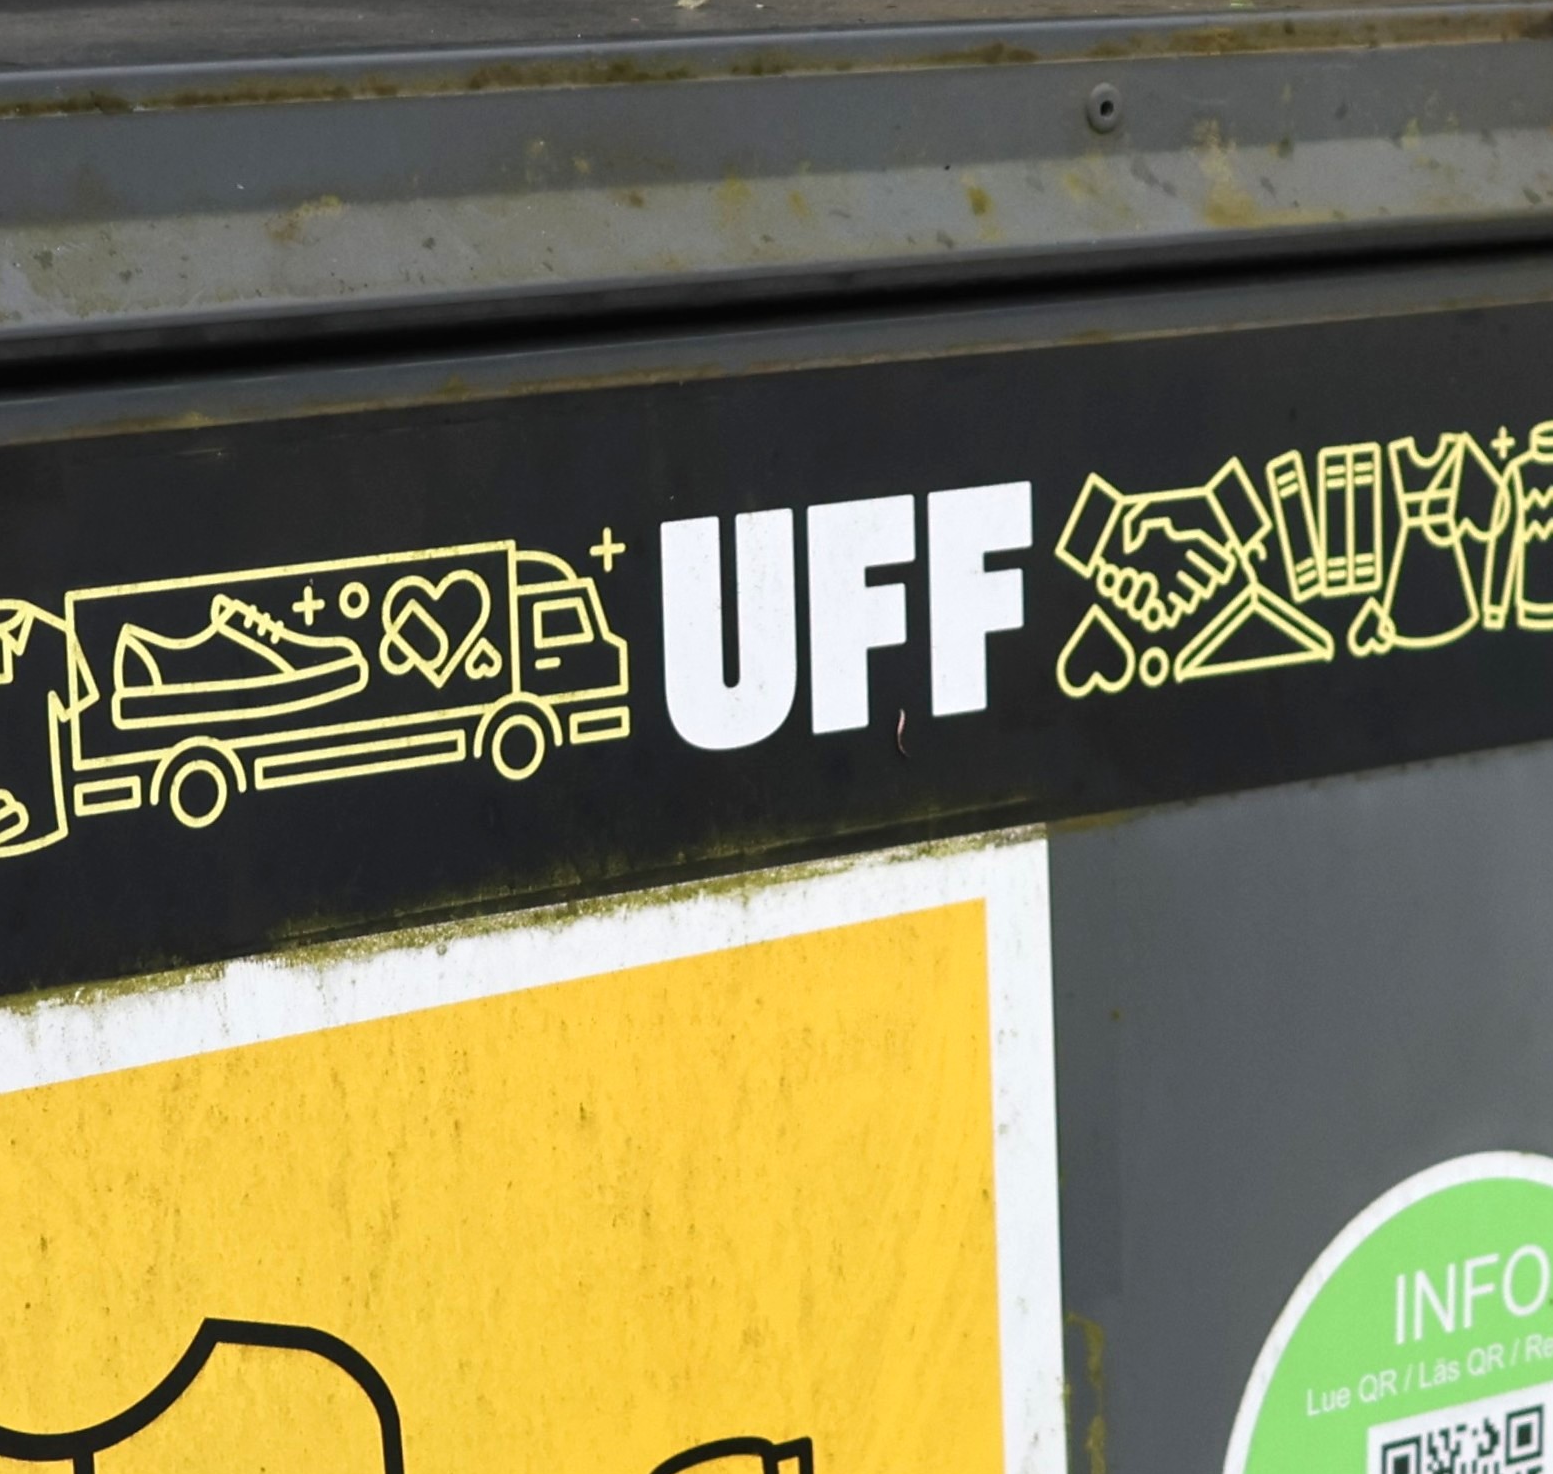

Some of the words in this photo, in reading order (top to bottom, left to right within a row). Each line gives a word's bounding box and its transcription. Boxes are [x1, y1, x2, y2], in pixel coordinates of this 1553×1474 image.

[660, 480, 1032, 751] UFF
[1394, 1243, 1551, 1345] INFO
[1306, 1388, 1351, 1416] Lue
[1358, 1369, 1397, 1403] QR
[1403, 1365, 1413, 1392] /
[1419, 1358, 1460, 1388] Läs
[1467, 1343, 1505, 1376] QR
[1510, 1338, 1520, 1366] /
